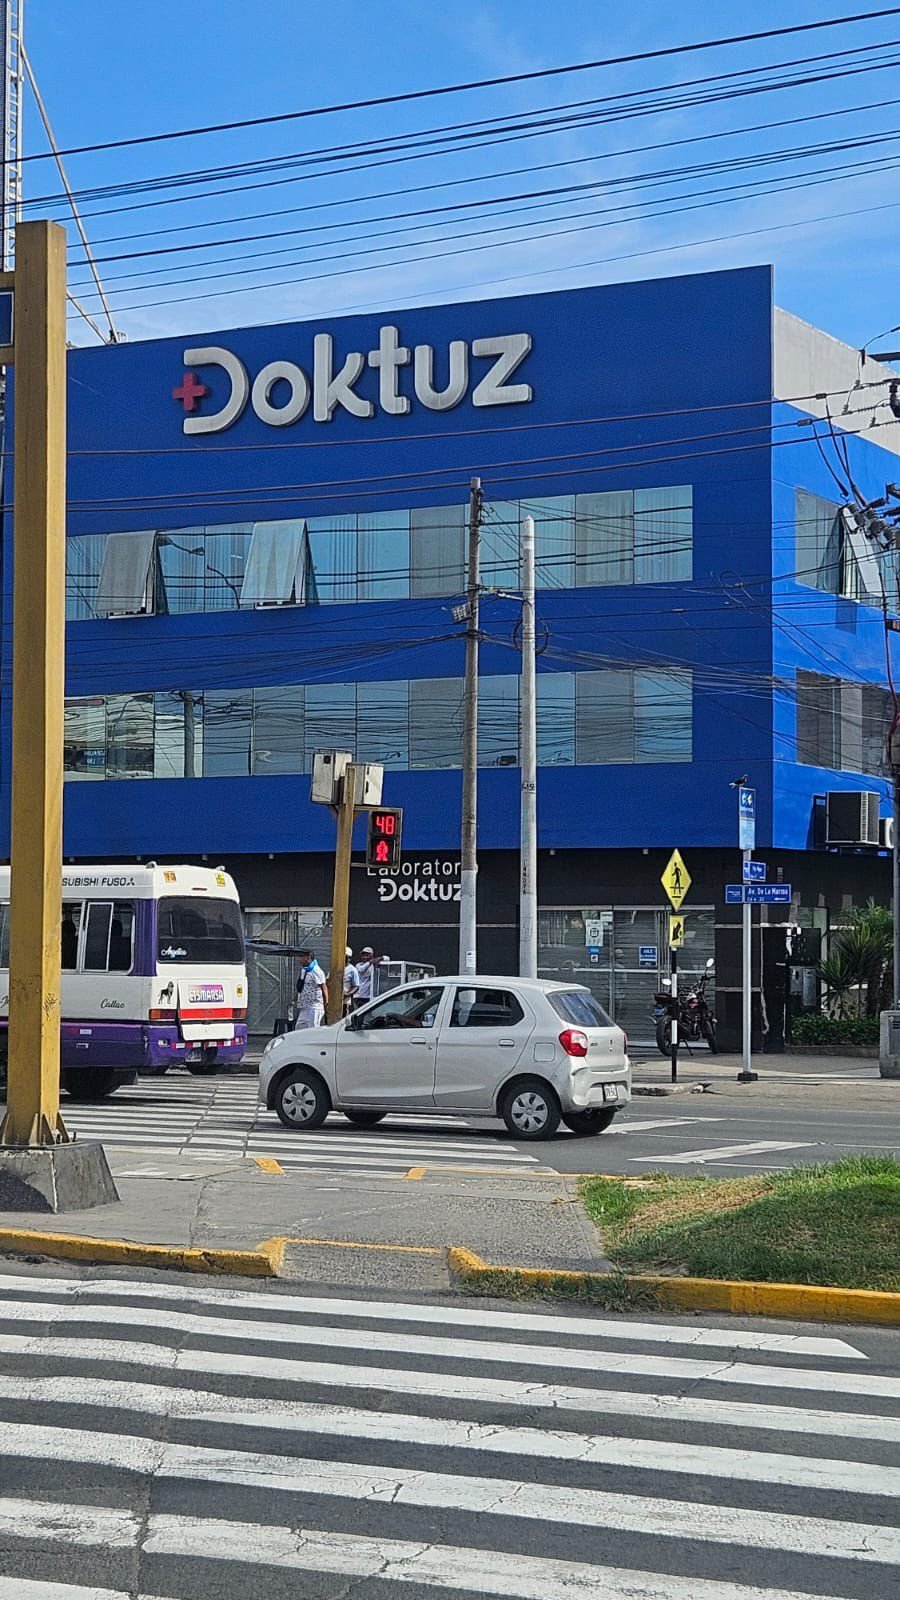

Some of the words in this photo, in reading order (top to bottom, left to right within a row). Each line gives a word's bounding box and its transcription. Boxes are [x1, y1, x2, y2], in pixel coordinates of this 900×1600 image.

[182, 325, 533, 435] Doktuz
[376, 815, 395, 835] 48
[61, 877, 99, 887] SUBISHI
[101, 877, 127, 887] FUSO
[100, 998, 126, 1009] Callao
